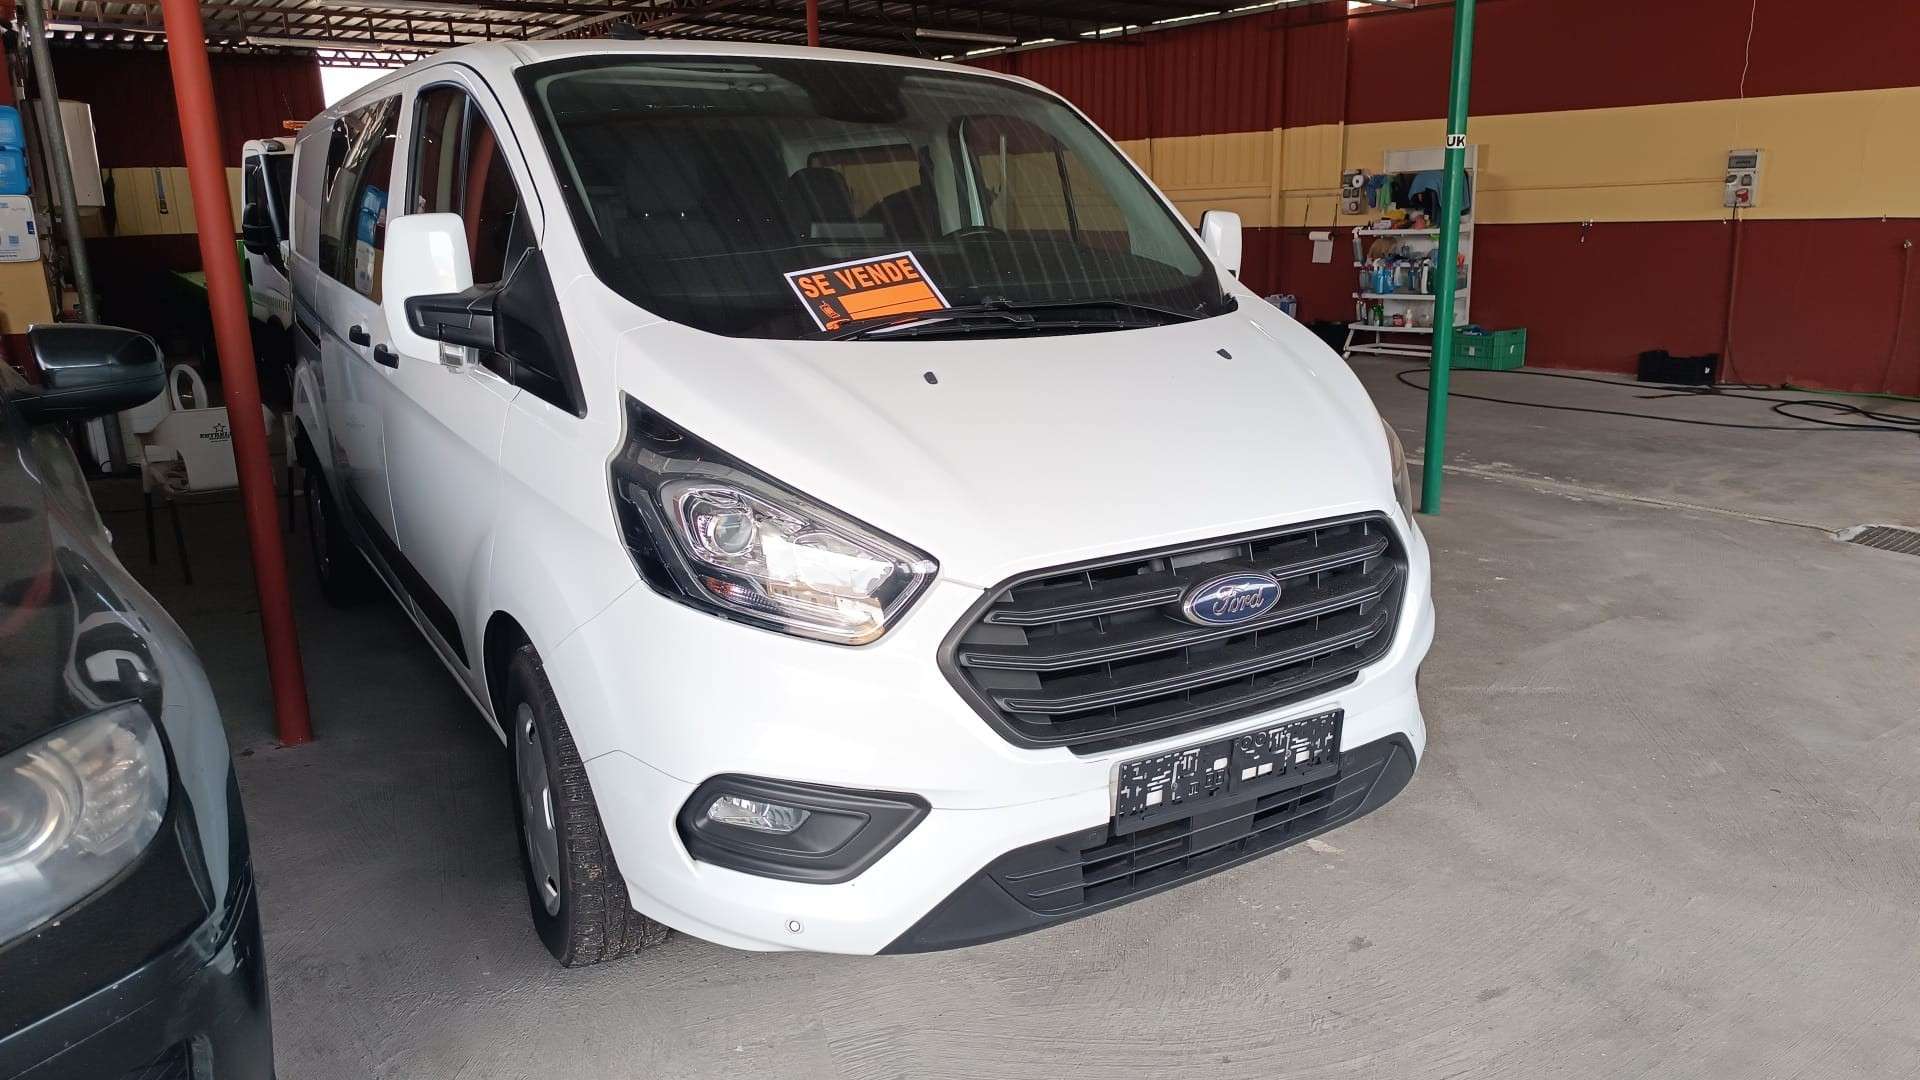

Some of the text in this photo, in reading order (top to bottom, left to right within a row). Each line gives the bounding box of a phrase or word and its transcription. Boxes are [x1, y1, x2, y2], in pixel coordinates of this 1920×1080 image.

[1447, 136, 1465, 147] UK
[799, 258, 919, 298] SE VENDE
[1212, 585, 1265, 616] Ford
